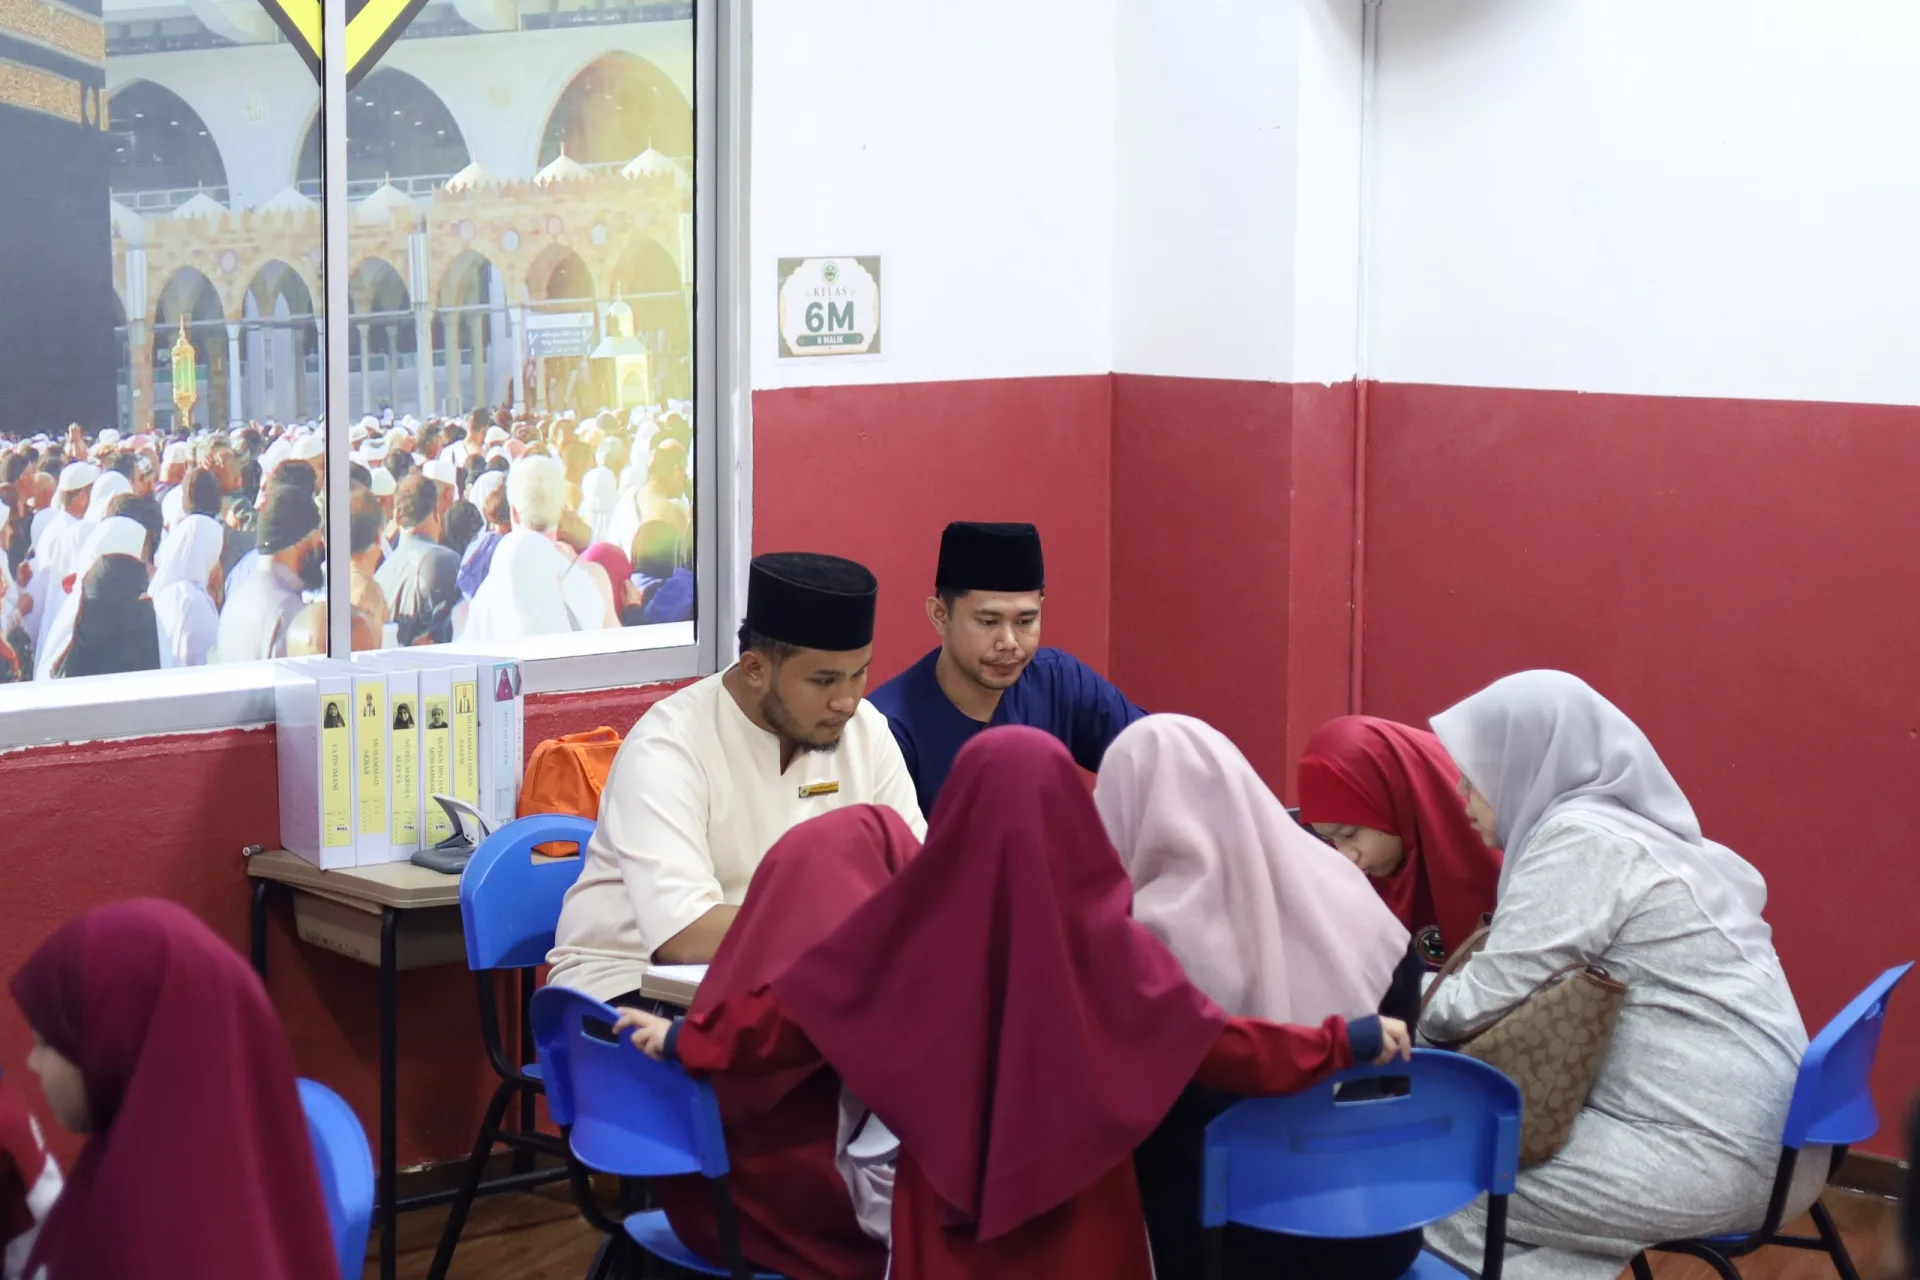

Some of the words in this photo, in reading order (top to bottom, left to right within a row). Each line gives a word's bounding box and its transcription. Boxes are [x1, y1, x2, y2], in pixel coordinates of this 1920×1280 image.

[814, 287, 848, 297] KELAS
[805, 301, 854, 333] 6M
[823, 335, 844, 344] MALIK
[331, 743, 339, 767] FATIN
[372, 737, 380, 786] MUHAMMAD
